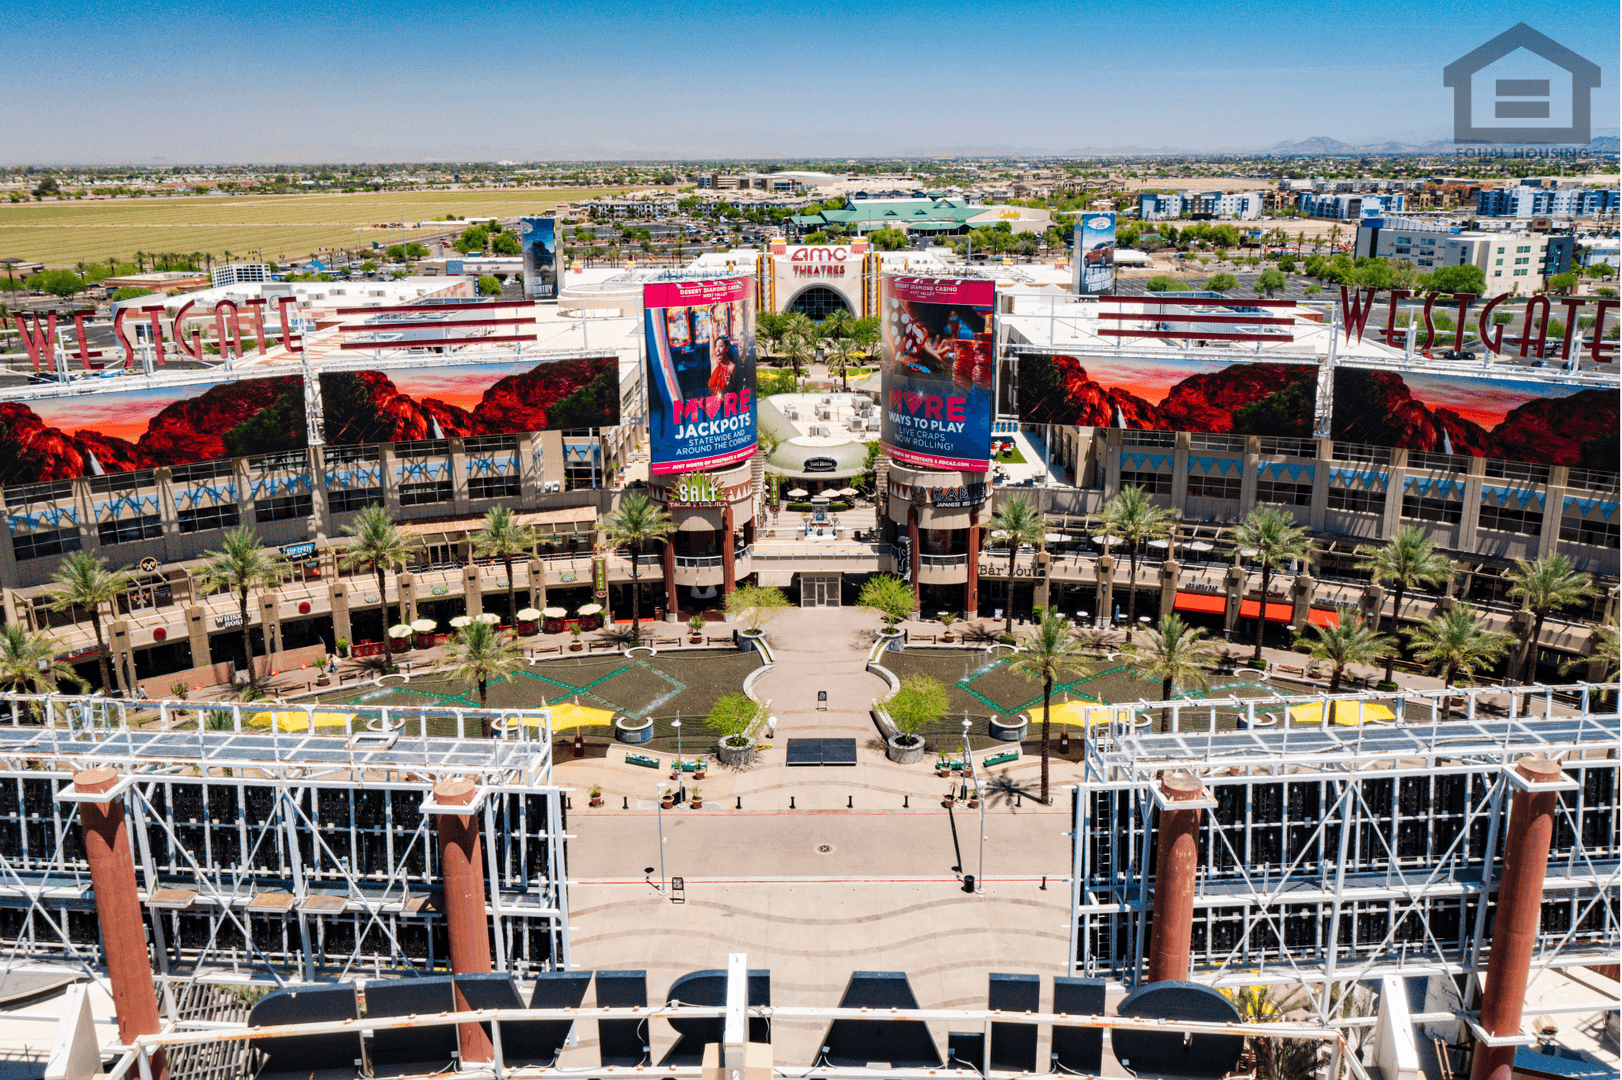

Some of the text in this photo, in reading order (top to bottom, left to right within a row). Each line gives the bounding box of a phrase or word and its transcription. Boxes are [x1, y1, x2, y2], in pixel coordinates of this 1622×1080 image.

[793, 265, 845, 275] THEATRES
[704, 285, 726, 293] DIAMOND
[1341, 285, 1621, 364] WESTGATE
[12, 296, 304, 378] WESTGATE
[675, 413, 751, 439] JACKPOTS
[888, 411, 965, 433] WAYS TO PLAY
[689, 429, 745, 446] STATEWIDE AND
[894, 433, 954, 451] NOW ROLLING!
[900, 427, 946, 442] LIVE CRAPS
[676, 435, 751, 455] AROUND THE CORNER!
[712, 456, 733, 464] WESTGATE
[911, 456, 934, 464] WESTGATE
[680, 482, 718, 502] SALT
[979, 564, 1004, 576] Bar
[215, 612, 252, 623] WHISKY
